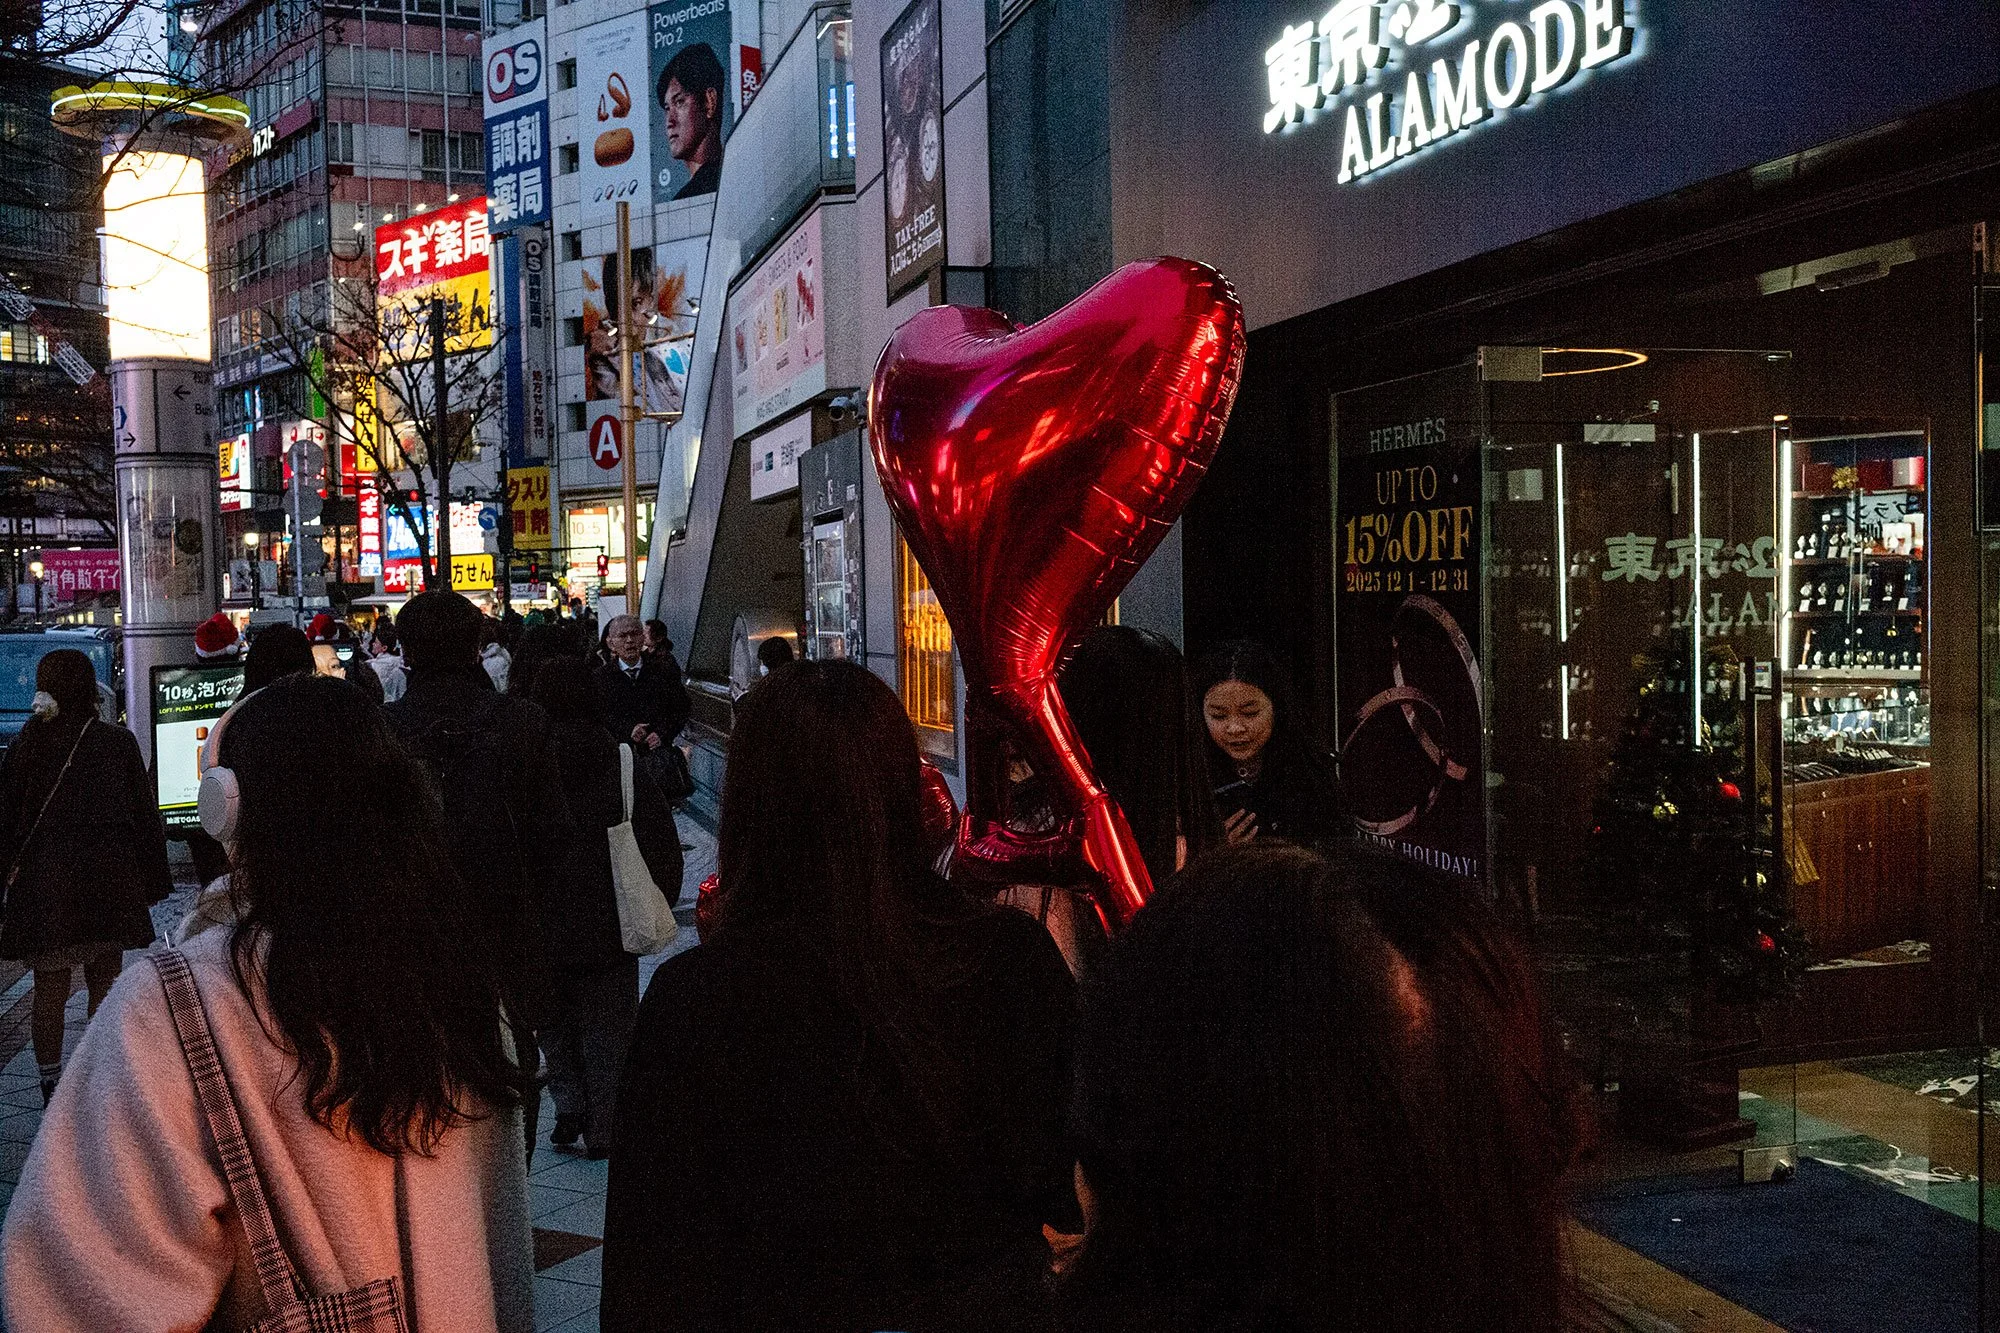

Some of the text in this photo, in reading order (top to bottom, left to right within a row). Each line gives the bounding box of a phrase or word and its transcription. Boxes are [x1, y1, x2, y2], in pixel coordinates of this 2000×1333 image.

[653, 0, 725, 30] Powerbeats
[654, 32, 675, 49] Pro
[676, 26, 684, 43] 2
[487, 41, 542, 93] OS
[253, 125, 275, 158] ガスト
[491, 109, 543, 173] 調剤
[493, 166, 544, 224] 薬局
[379, 209, 490, 282] スギ薬局
[895, 204, 936, 248] TAX-FREE
[596, 421, 620, 461] A
[1377, 465, 1437, 505] UP TO
[1347, 572, 1381, 592] 2025
[1387, 571, 1401, 592] 12
[1431, 570, 1447, 591] 12
[1453, 569, 1469, 591] 31
[1402, 842, 1478, 878] HOLIDAY!
